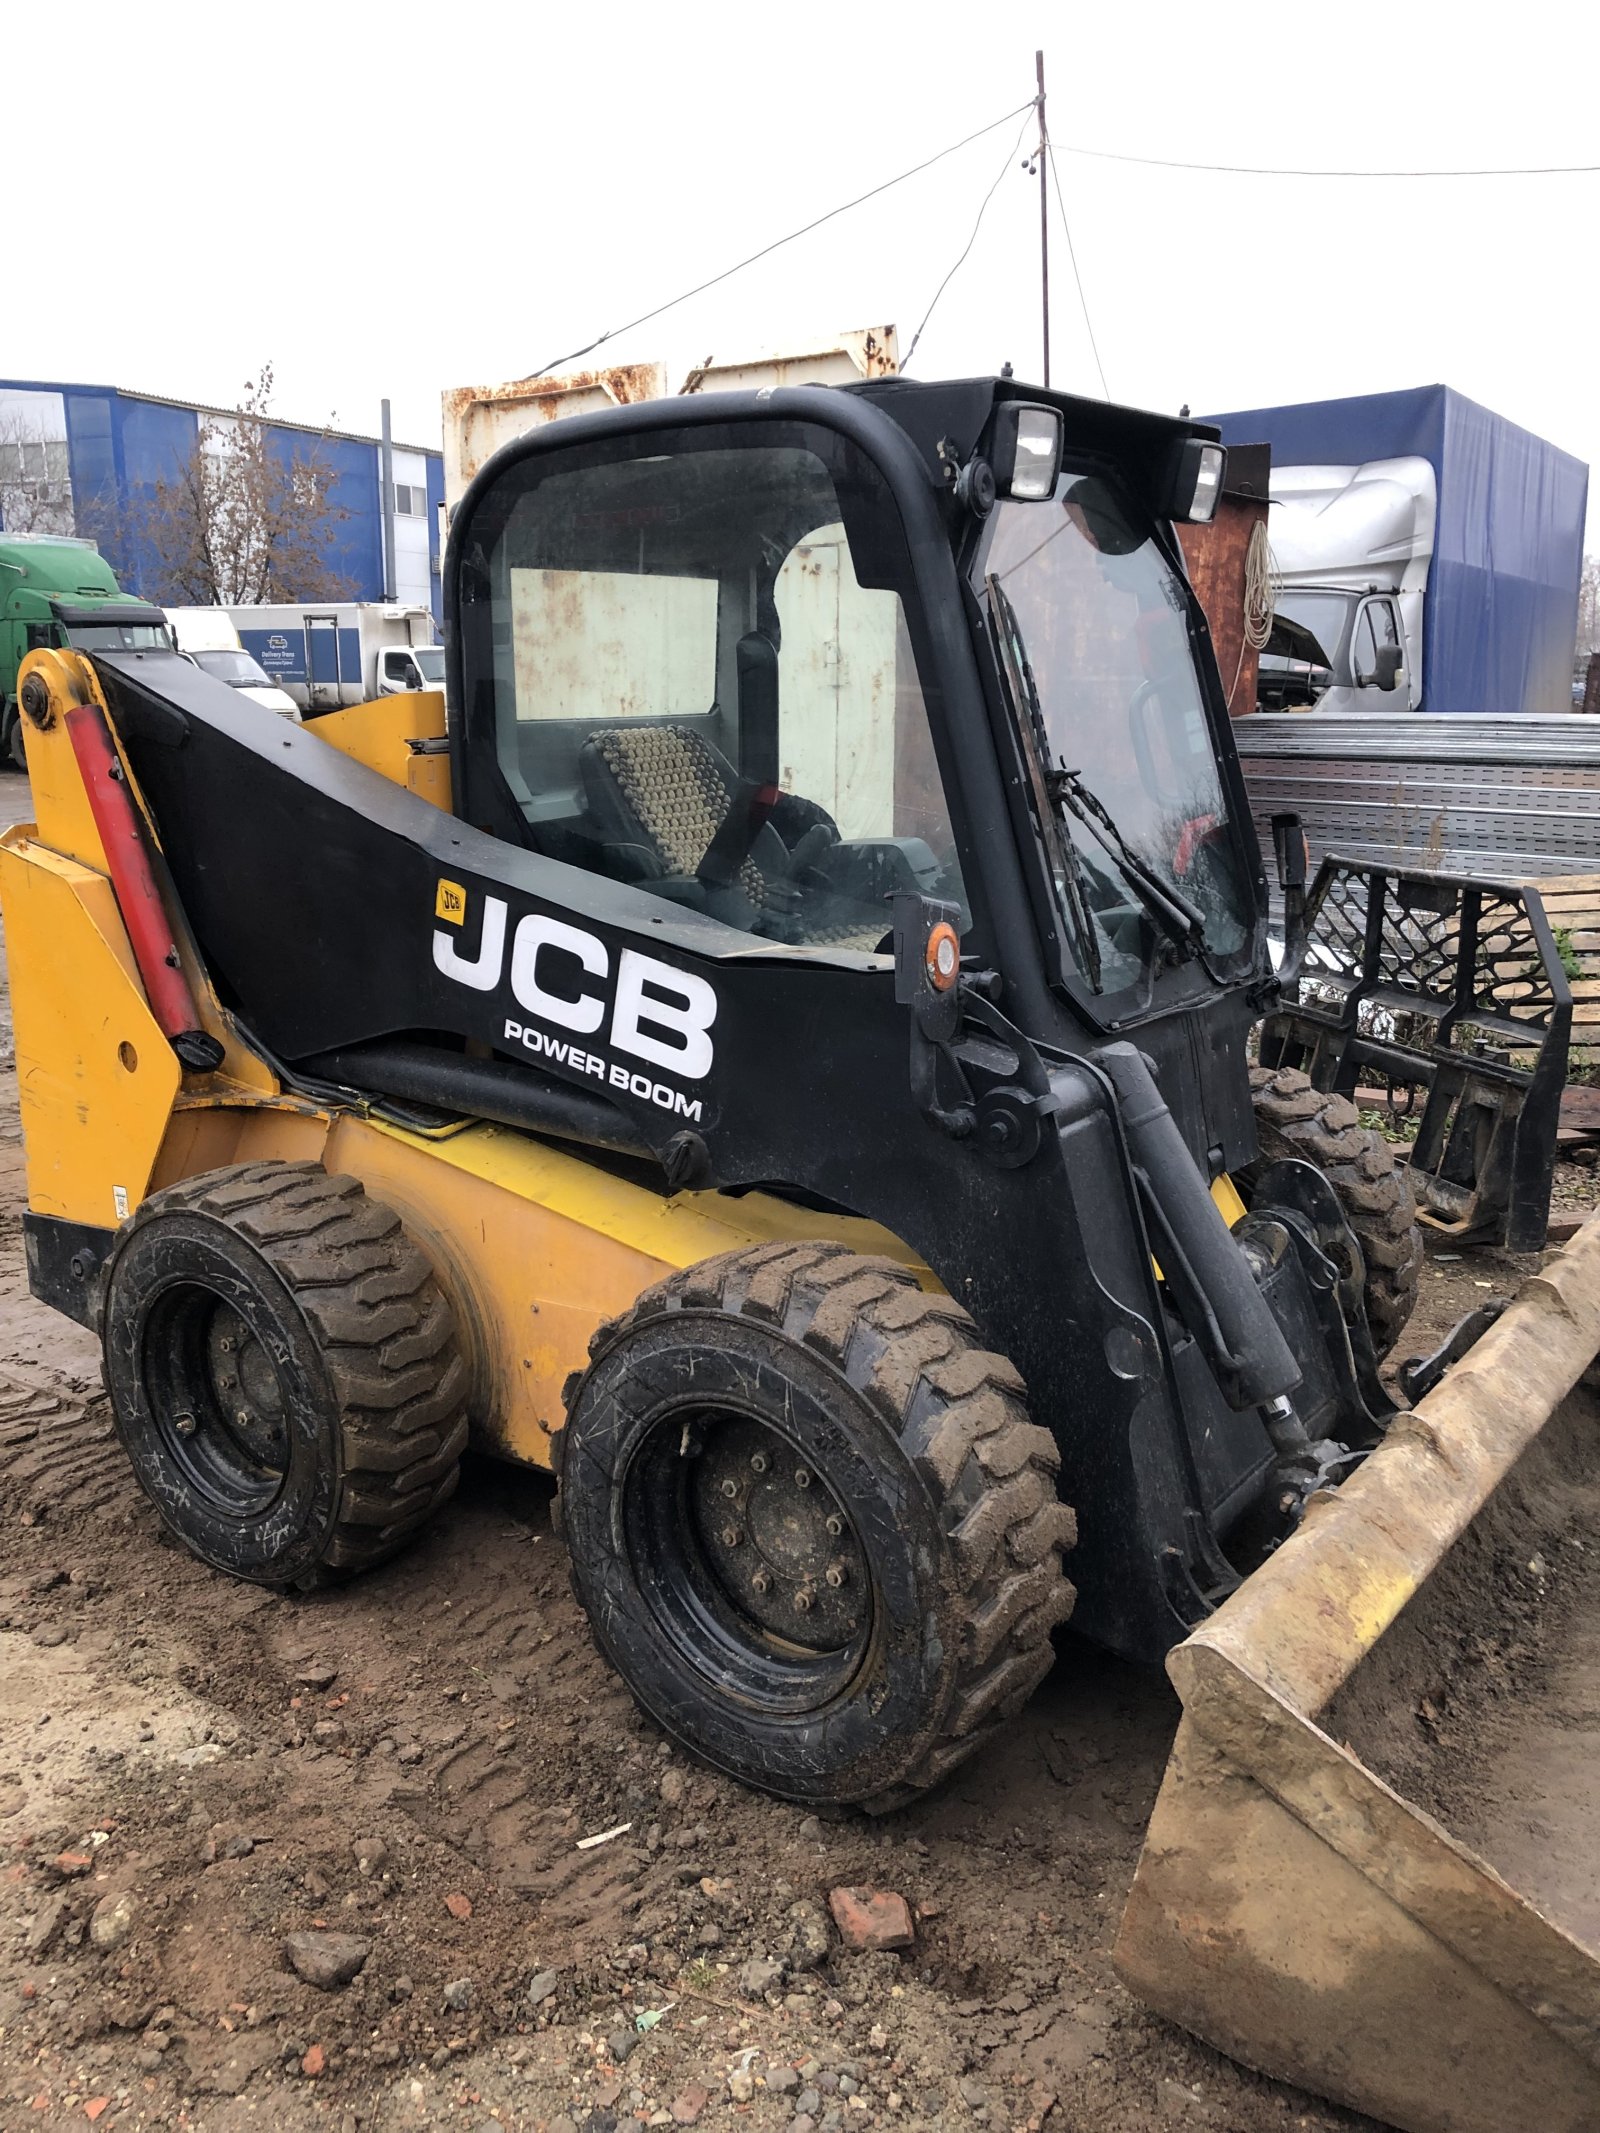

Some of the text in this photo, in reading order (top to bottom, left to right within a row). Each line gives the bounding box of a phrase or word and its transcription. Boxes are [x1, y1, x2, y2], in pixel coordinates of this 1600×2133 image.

[261, 651, 281, 659] Delivery
[444, 890, 461, 910] JCB
[433, 894, 718, 1079] JCB
[504, 1018, 703, 1122] POWER BOOM
